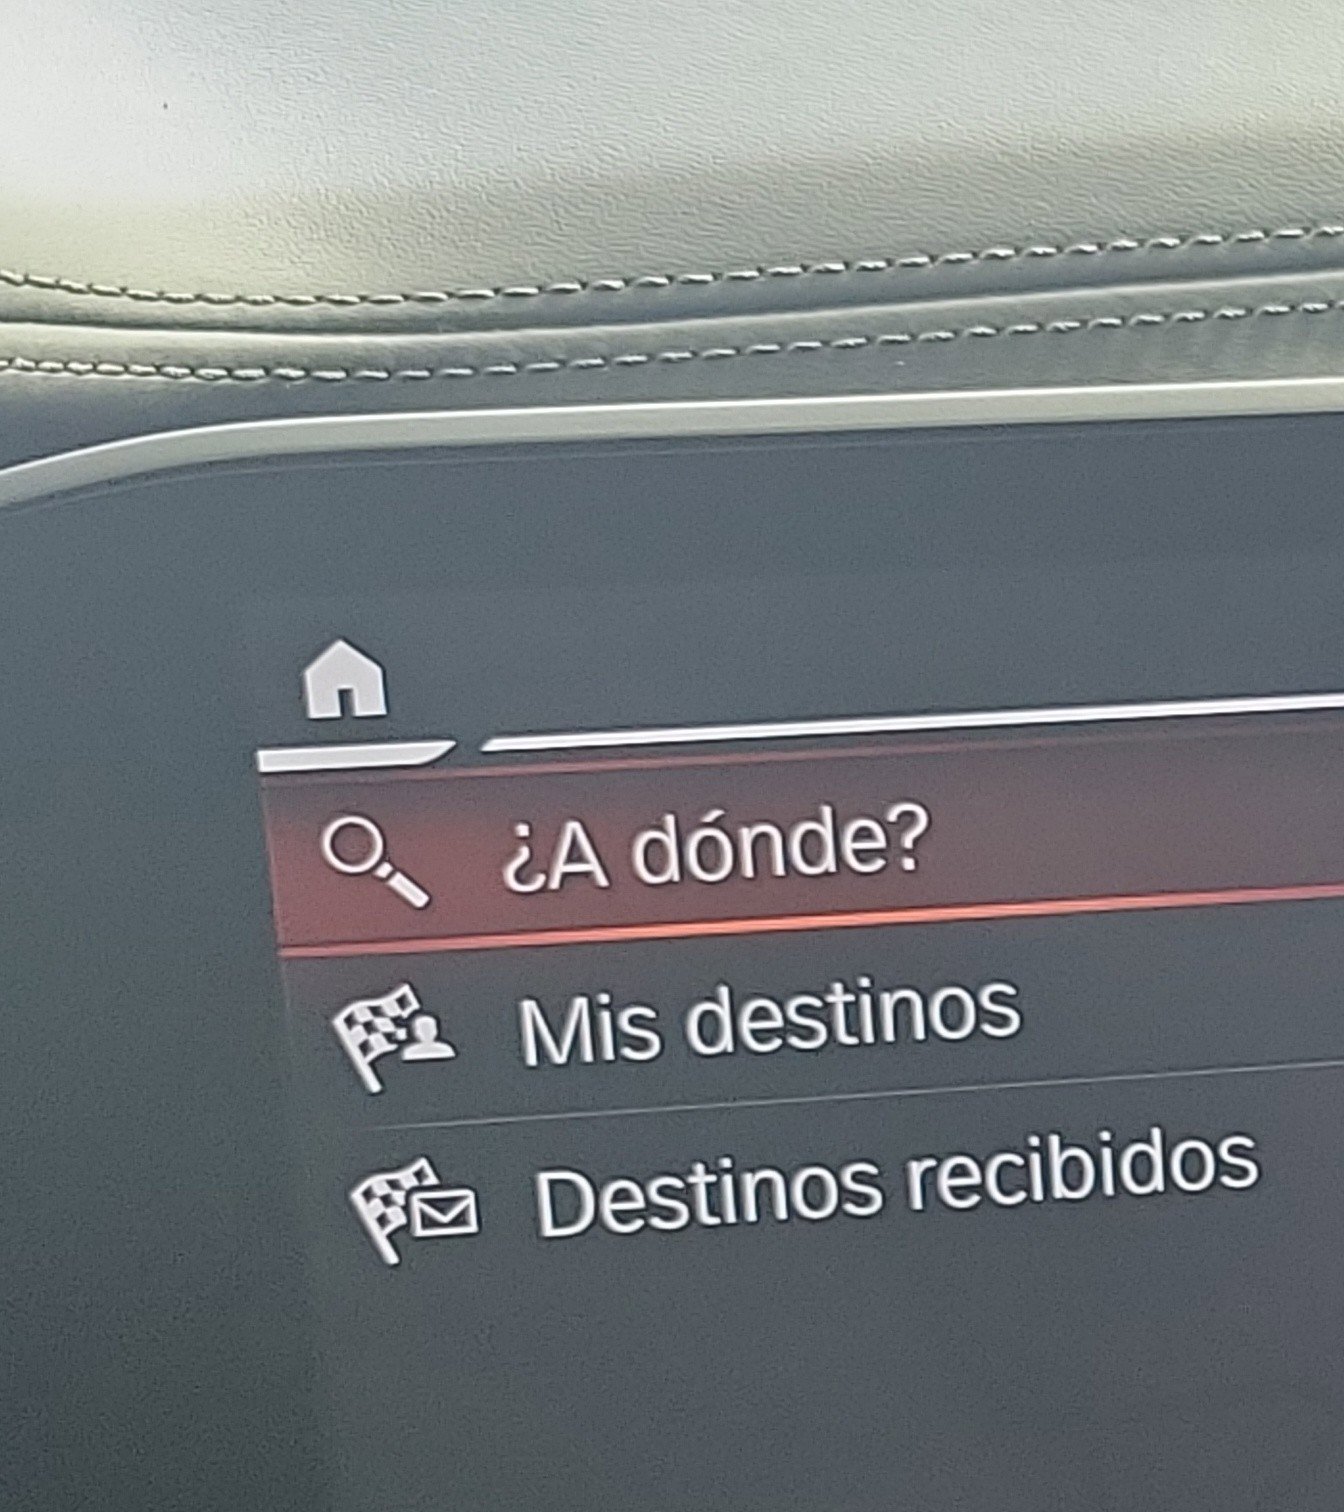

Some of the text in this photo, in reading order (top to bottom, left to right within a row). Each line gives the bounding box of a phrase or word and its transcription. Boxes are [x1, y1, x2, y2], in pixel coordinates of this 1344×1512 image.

[502, 803, 929, 895] ¿A dónde?
[519, 976, 1022, 1067] Mis destinos
[536, 1128, 1260, 1240] Destinos recibidos
